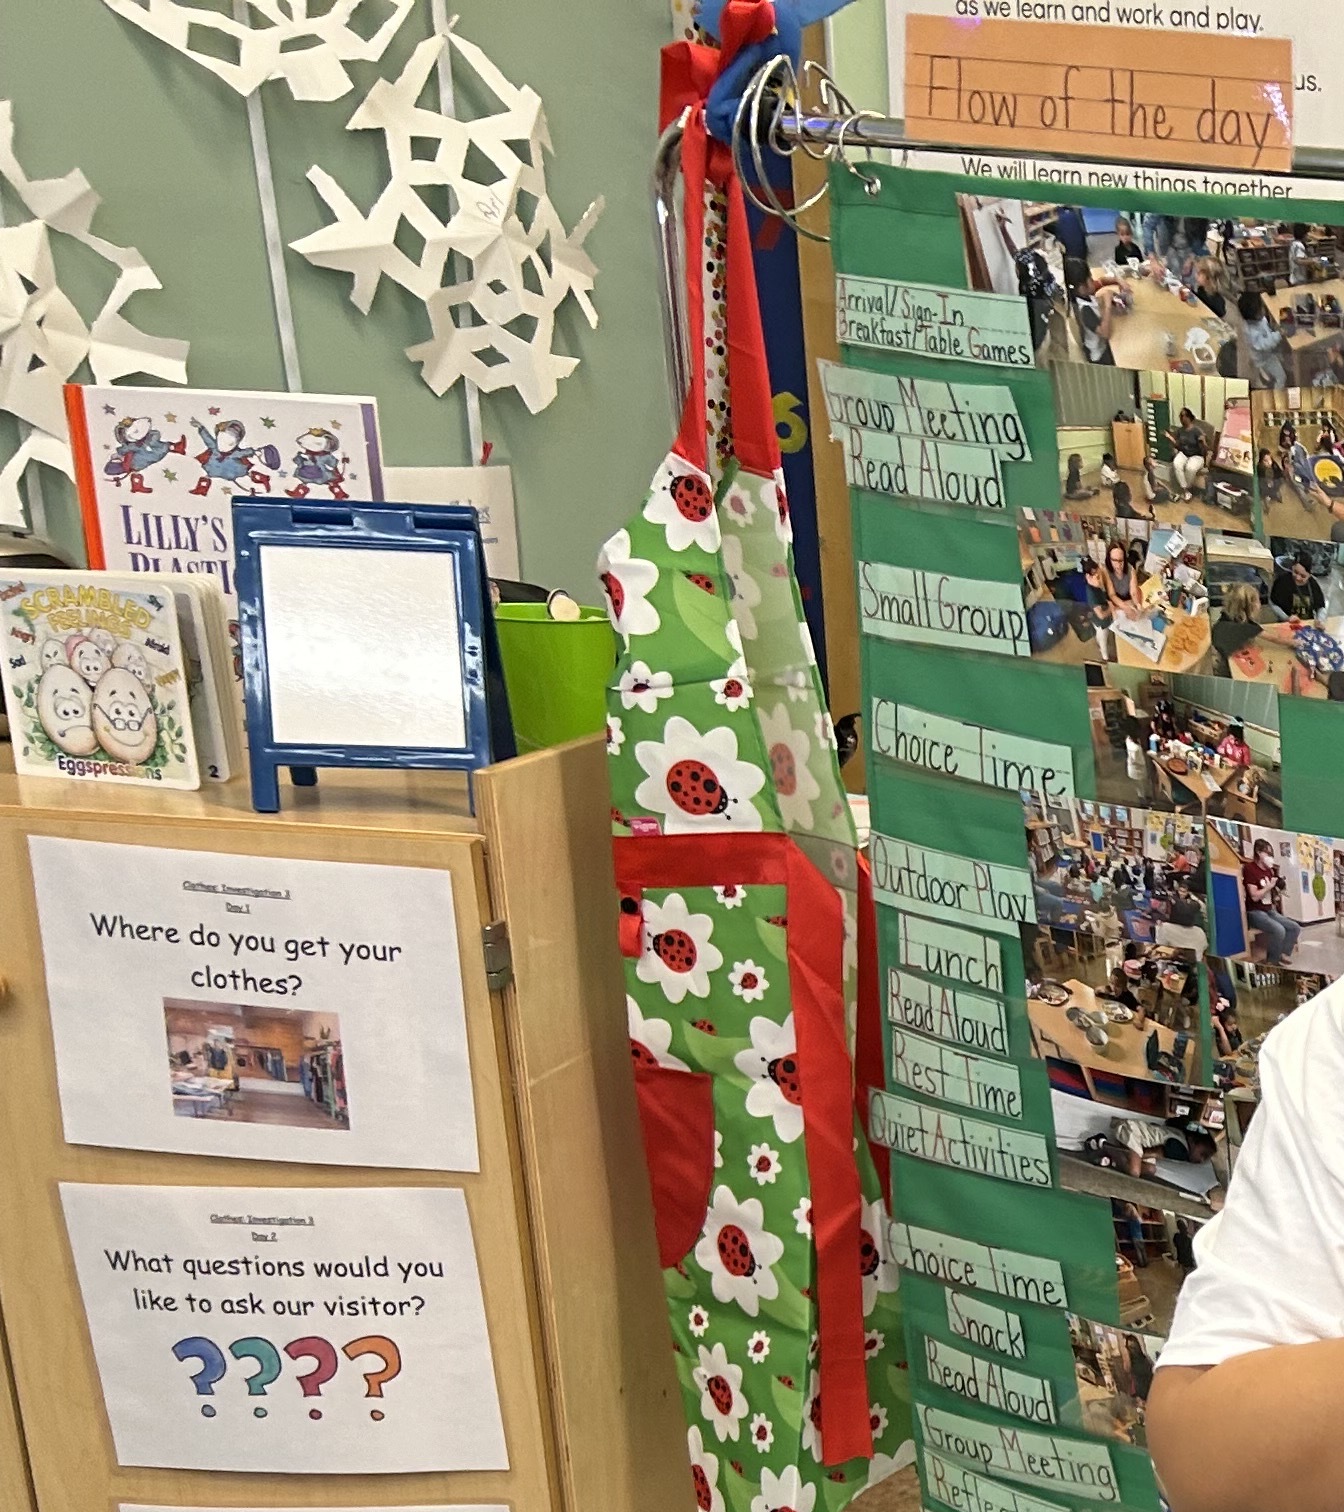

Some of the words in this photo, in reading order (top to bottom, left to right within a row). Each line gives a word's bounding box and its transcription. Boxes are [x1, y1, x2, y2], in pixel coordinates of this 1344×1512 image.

[986, 2, 1011, 17] we
[1017, 1, 1066, 20] learn
[1071, 2, 1110, 22] and
[1117, 5, 1164, 26] work
[1170, 6, 1209, 28] and
[1217, 9, 1264, 31] play.
[925, 56, 1017, 128] Flow
[1041, 65, 1079, 129] of
[1105, 68, 1173, 140] the
[1197, 78, 1274, 167] day
[961, 156, 991, 176] We
[997, 160, 1027, 180] will
[1033, 163, 1081, 184] learn
[1088, 170, 1128, 189] new
[1133, 171, 1196, 191] things
[968, 327, 1030, 365] Games
[897, 376, 1025, 460] Meeting
[850, 427, 908, 494] Read
[921, 436, 1001, 508] Aloud
[120, 505, 227, 553] LILLY'S
[21, 585, 152, 631] SCRAMBLED
[861, 559, 933, 632] Small
[937, 576, 1026, 656] Group
[874, 699, 959, 774] Choice
[963, 721, 1071, 796] Time
[873, 837, 967, 907] Outdoor
[89, 913, 180, 944] Where
[189, 924, 220, 948] do
[228, 933, 275, 955] you
[285, 935, 330, 962] get
[338, 941, 402, 964] your
[901, 912, 1001, 986] Lunch
[190, 967, 302, 997] clothes?
[888, 970, 933, 1030] Read
[939, 984, 1007, 1054] Aloud
[894, 1031, 947, 1092] Rest
[954, 1052, 1021, 1119] Time
[870, 1090, 930, 1147] Quiet
[932, 1113, 1049, 1185] Activities
[104, 1249, 174, 1274] What
[183, 1255, 305, 1280] questions
[315, 1256, 389, 1278] would
[397, 1260, 444, 1284] you
[888, 1223, 977, 1288] Choice
[988, 1246, 1062, 1306] Time
[133, 1288, 178, 1311] like
[185, 1293, 211, 1314] to
[221, 1295, 266, 1316] ask
[273, 1298, 313, 1317] our
[324, 1295, 426, 1317] visitor?
[949, 1289, 1025, 1358] Snack
[928, 1338, 979, 1400] Read
[986, 1363, 1051, 1424] Aloud
[926, 1405, 993, 1471] Group
[999, 1428, 1115, 1501] Meeting
